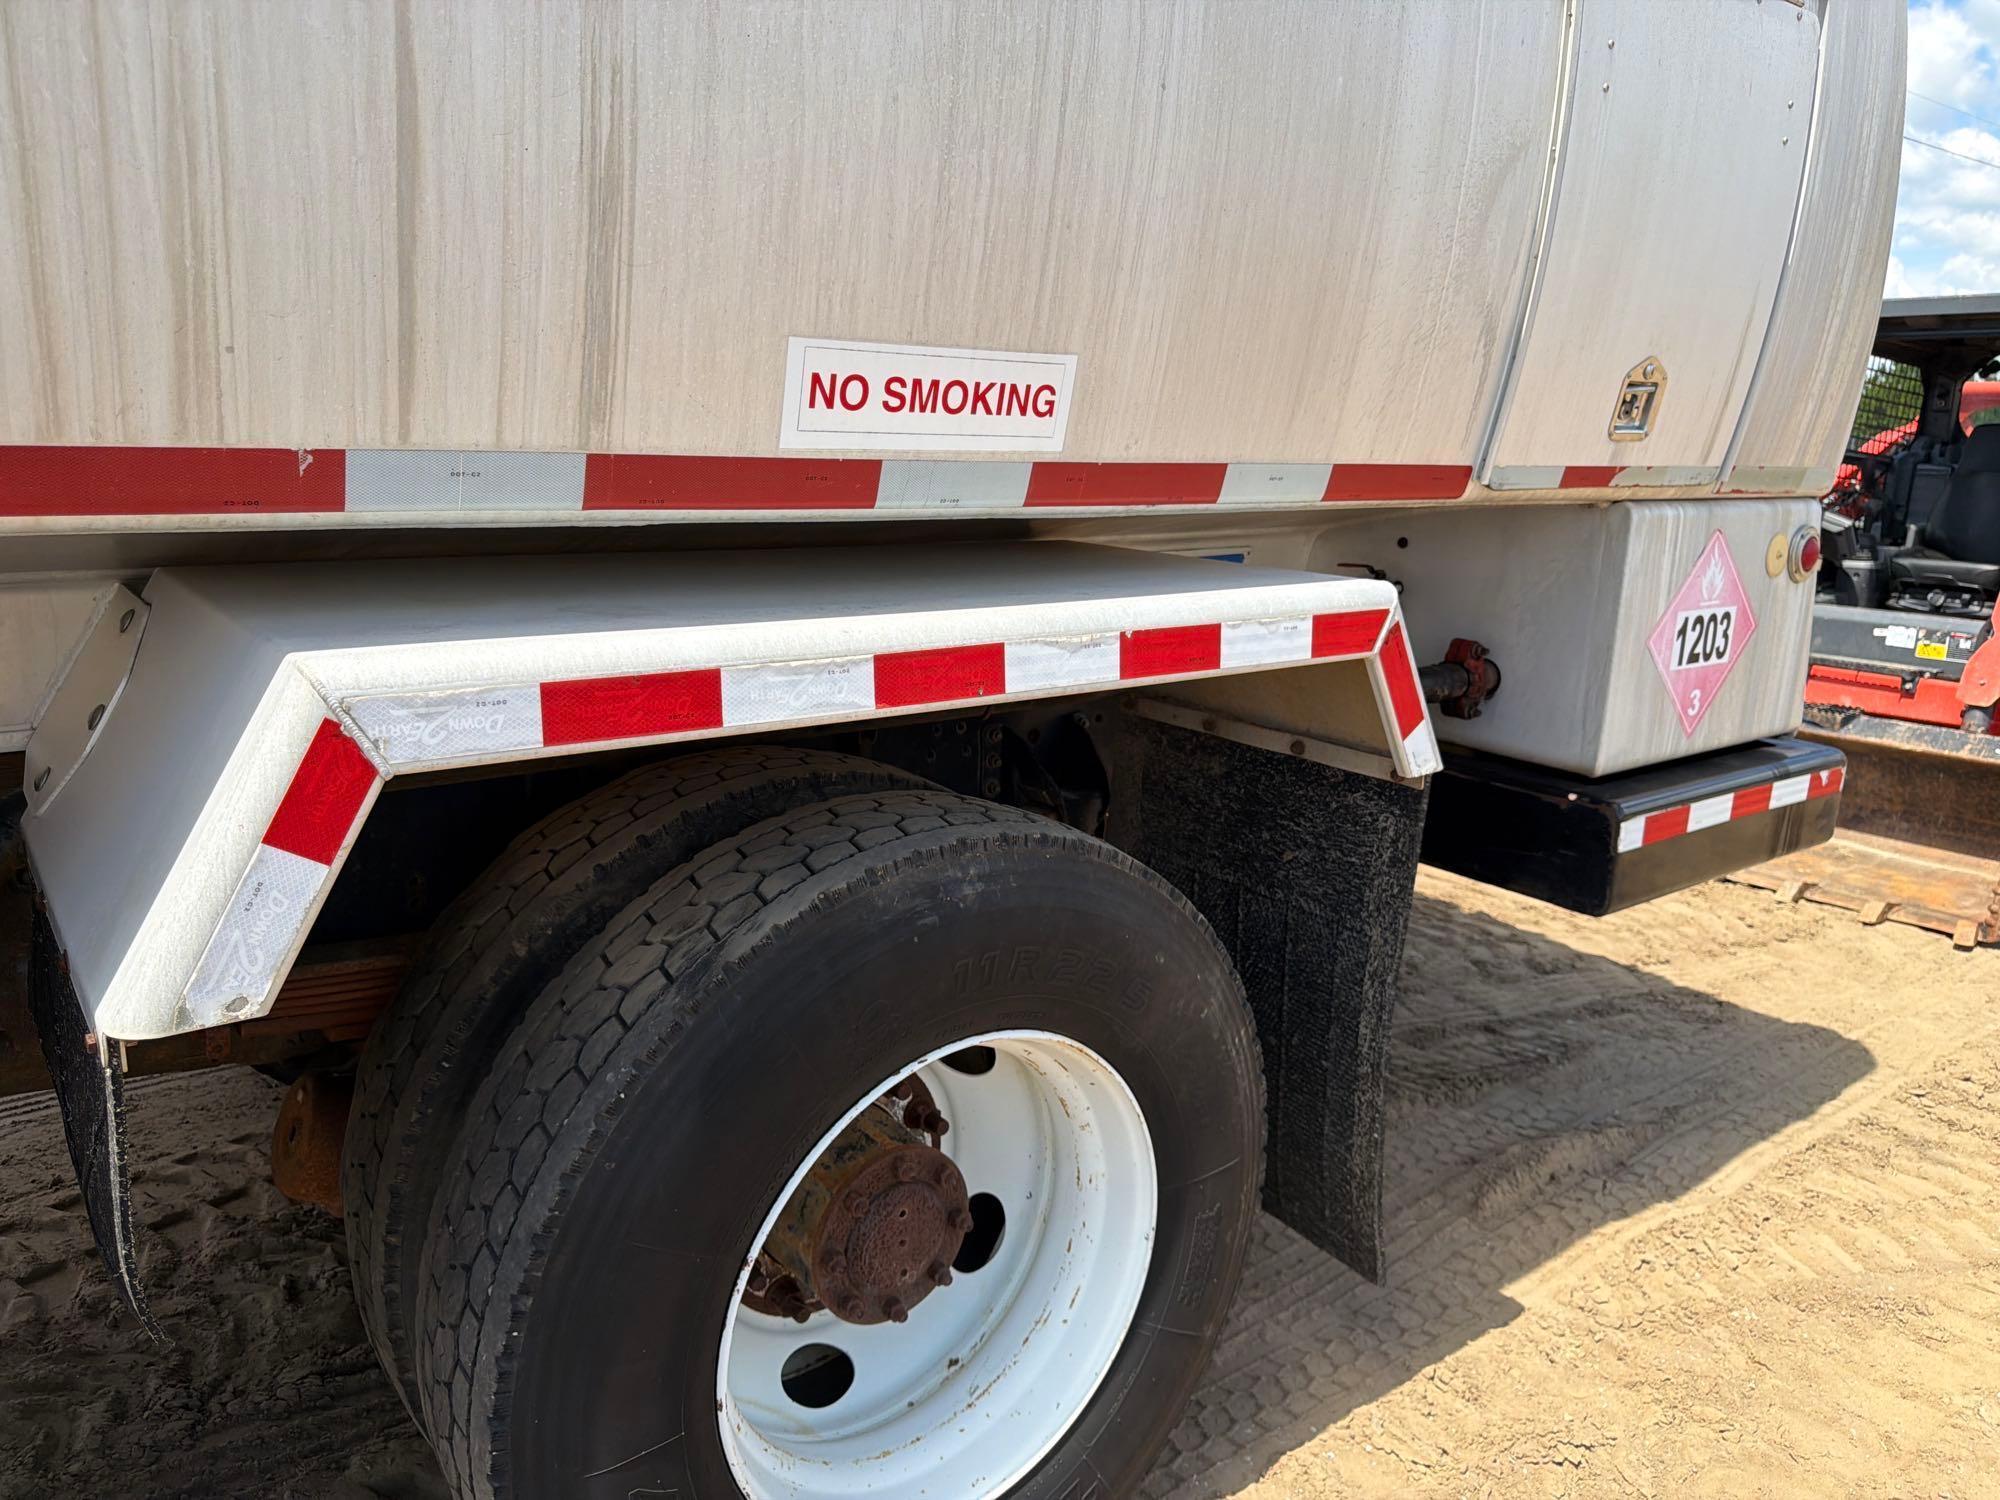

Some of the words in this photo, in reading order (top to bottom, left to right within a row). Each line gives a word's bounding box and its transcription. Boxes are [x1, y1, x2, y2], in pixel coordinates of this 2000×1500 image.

[808, 372, 870, 412] NO
[881, 376, 1057, 418] SMOKING
[1675, 610, 1731, 667] 1203
[475, 699, 508, 707] DOT-C2
[1687, 688, 1701, 716] 3
[243, 881, 264, 912] DOT-C2
